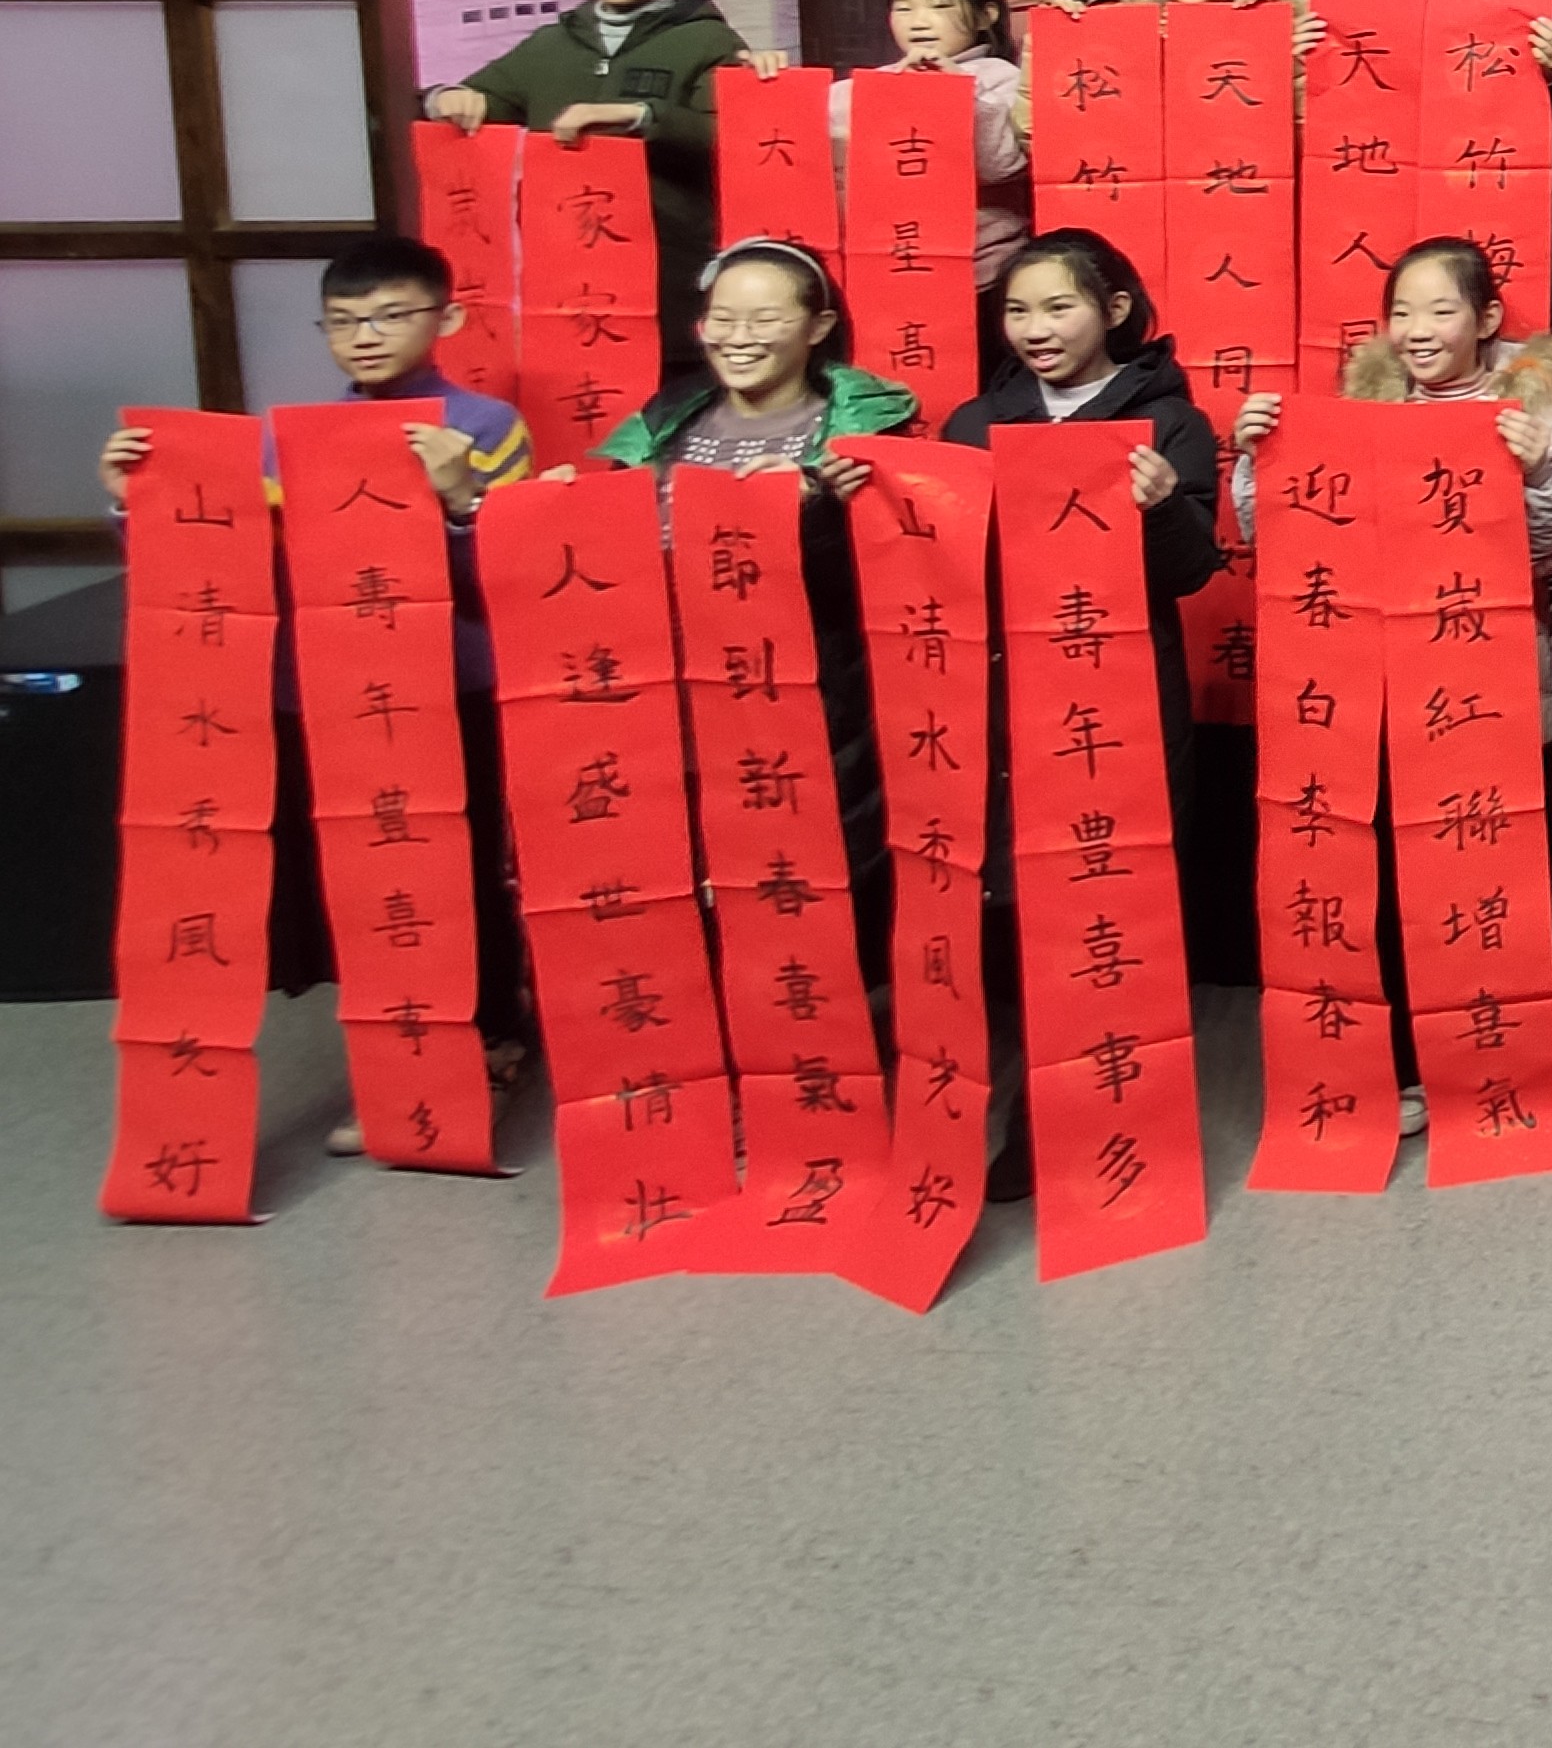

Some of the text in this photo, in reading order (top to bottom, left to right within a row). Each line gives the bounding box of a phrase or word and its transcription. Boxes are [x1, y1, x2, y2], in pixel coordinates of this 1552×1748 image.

[1060, 57, 1129, 202] 松竹
[556, 183, 632, 438] 家家幸
